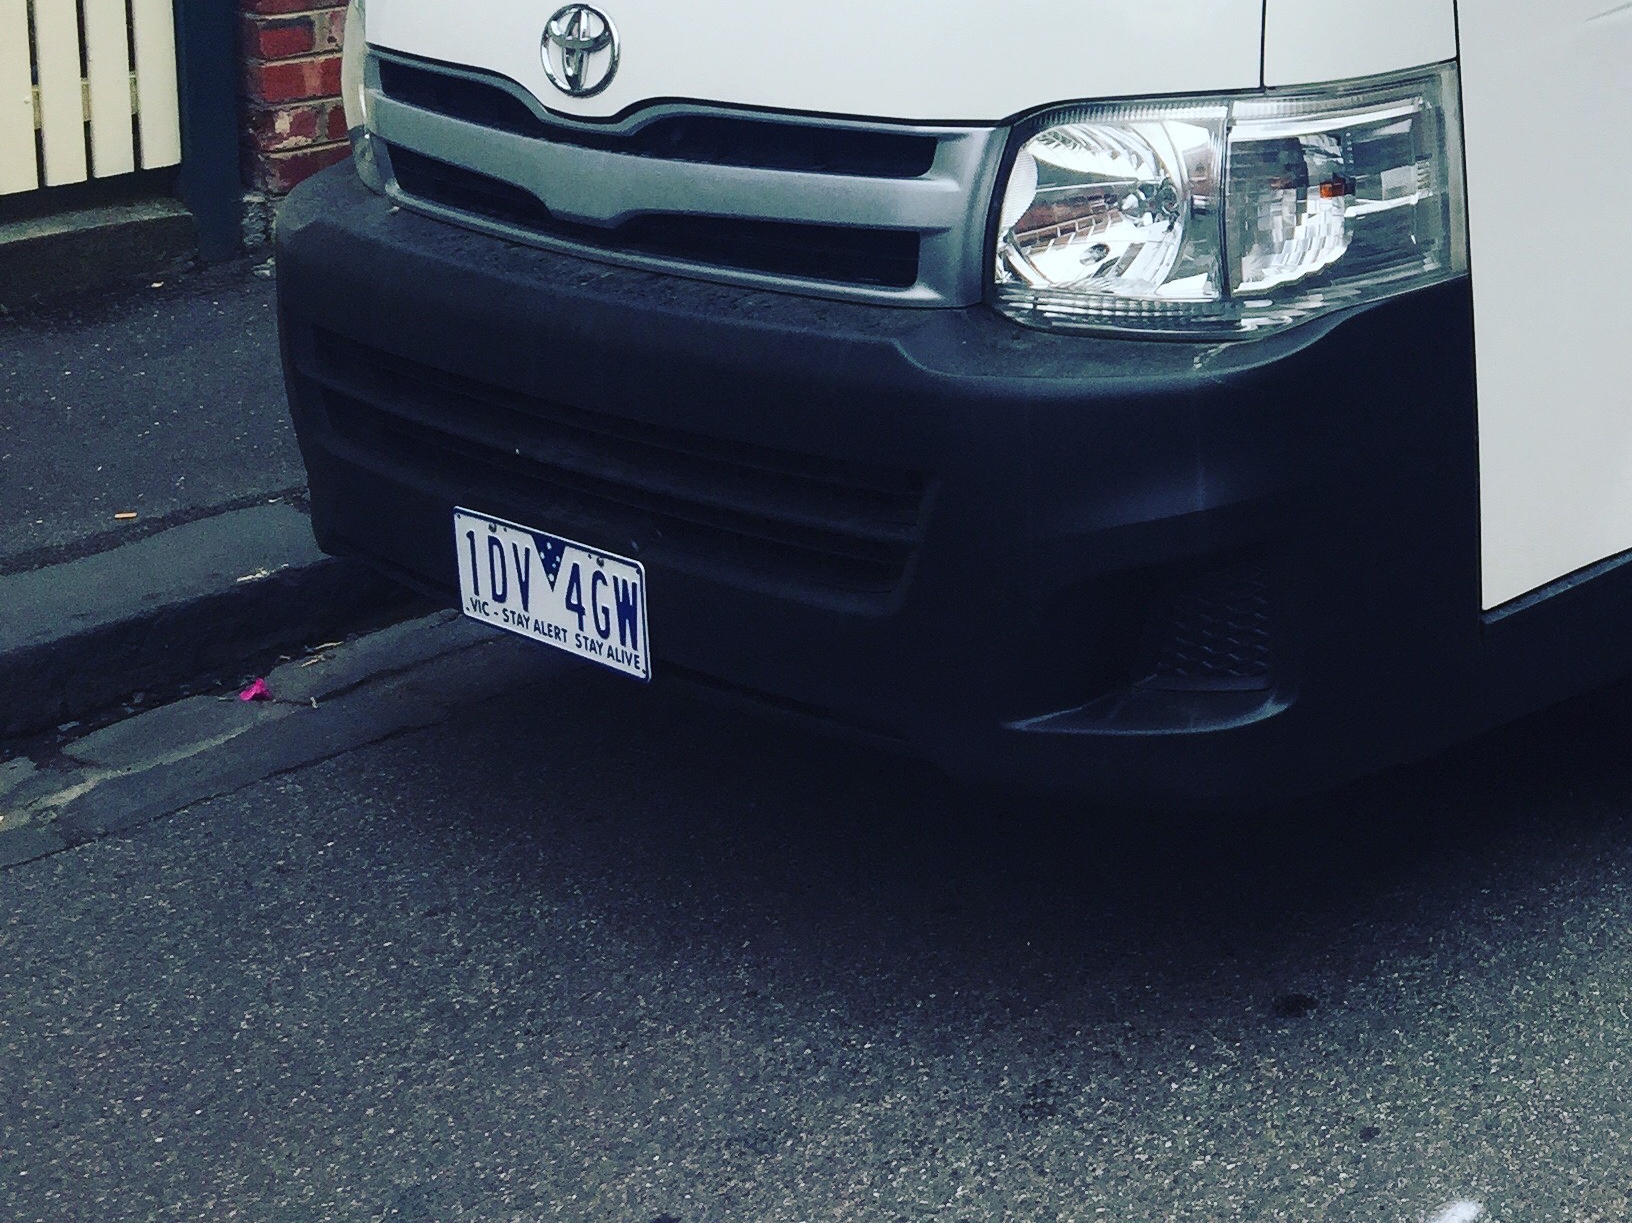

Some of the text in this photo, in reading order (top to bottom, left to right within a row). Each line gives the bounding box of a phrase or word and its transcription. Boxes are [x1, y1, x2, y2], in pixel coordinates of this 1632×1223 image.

[466, 530, 638, 651] 1DV 4GW
[469, 597, 490, 617] VIC
[503, 608, 531, 630] STAY
[533, 619, 568, 643] ALERT
[575, 632, 604, 657] STAY
[606, 645, 641, 670] ALIVE
